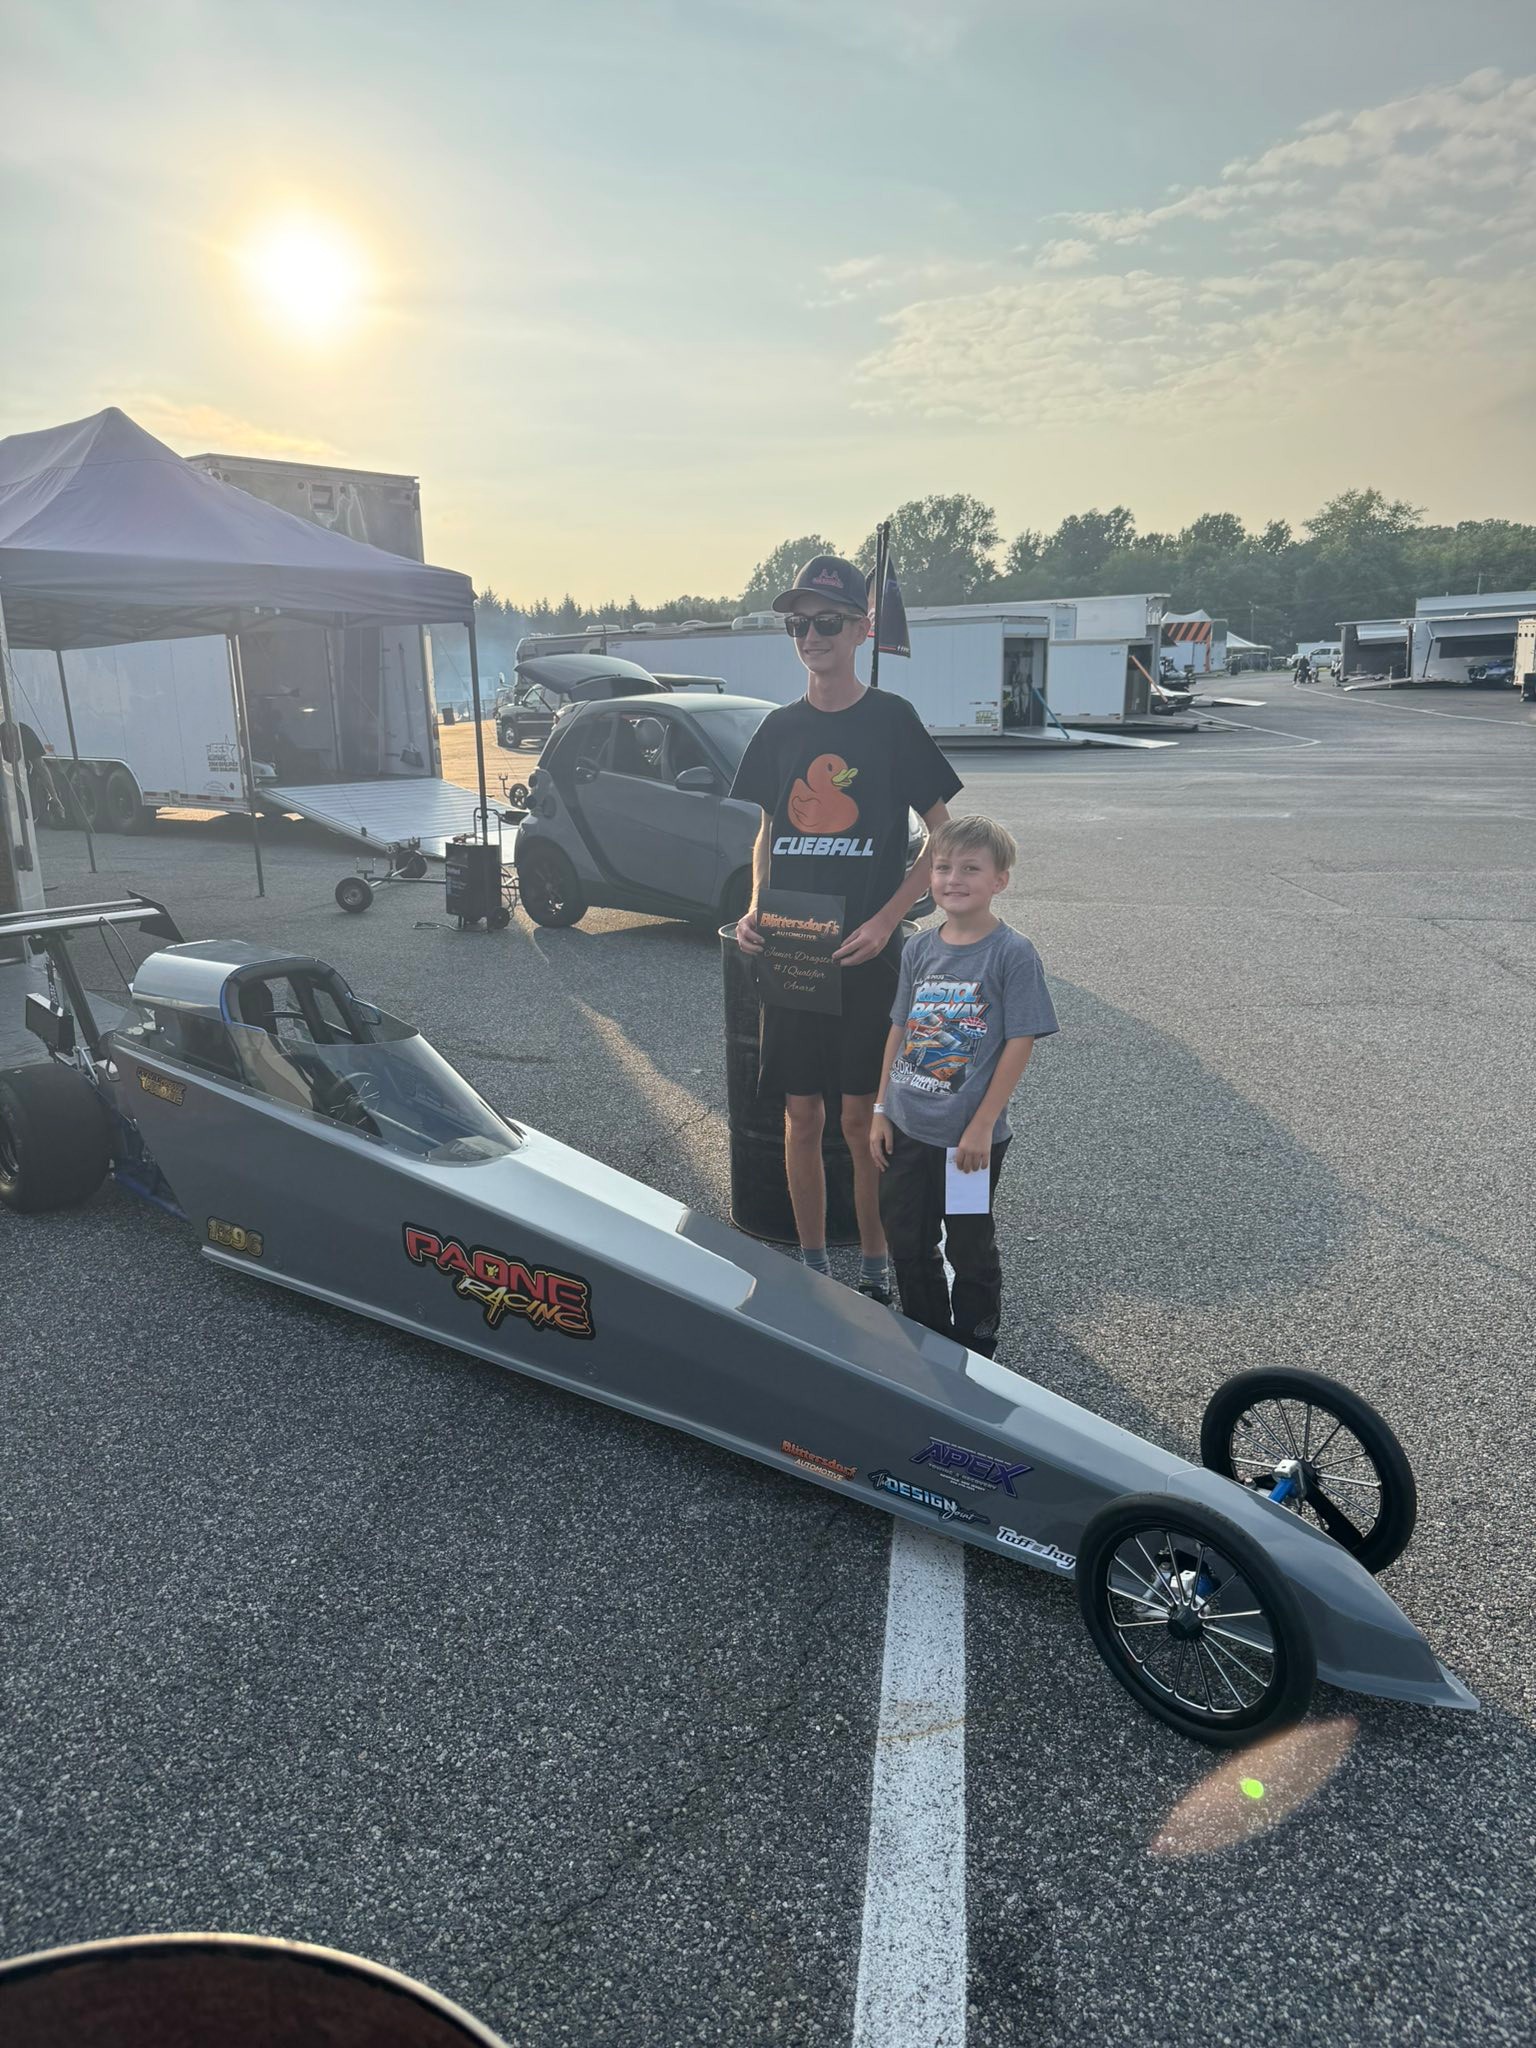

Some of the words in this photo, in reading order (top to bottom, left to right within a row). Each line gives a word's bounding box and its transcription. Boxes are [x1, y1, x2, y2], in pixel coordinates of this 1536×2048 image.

[772, 836, 874, 857] CUEBALL
[776, 930, 817, 940] AUTOMOTIVE
[764, 946, 793, 960] Junior
[787, 965, 826, 980] Qualifier
[783, 981, 817, 993] Award
[406, 1227, 587, 1313] PAONE
[458, 1277, 592, 1334] RACING
[794, 1458, 844, 1481] AUTOMOTIVE
[911, 1441, 1031, 1497] APEX
[886, 1476, 958, 1514] DESIGN
[941, 1503, 981, 1521] Joint
[999, 1527, 1035, 1548] Tuff
[1042, 1546, 1076, 1567] Jug
